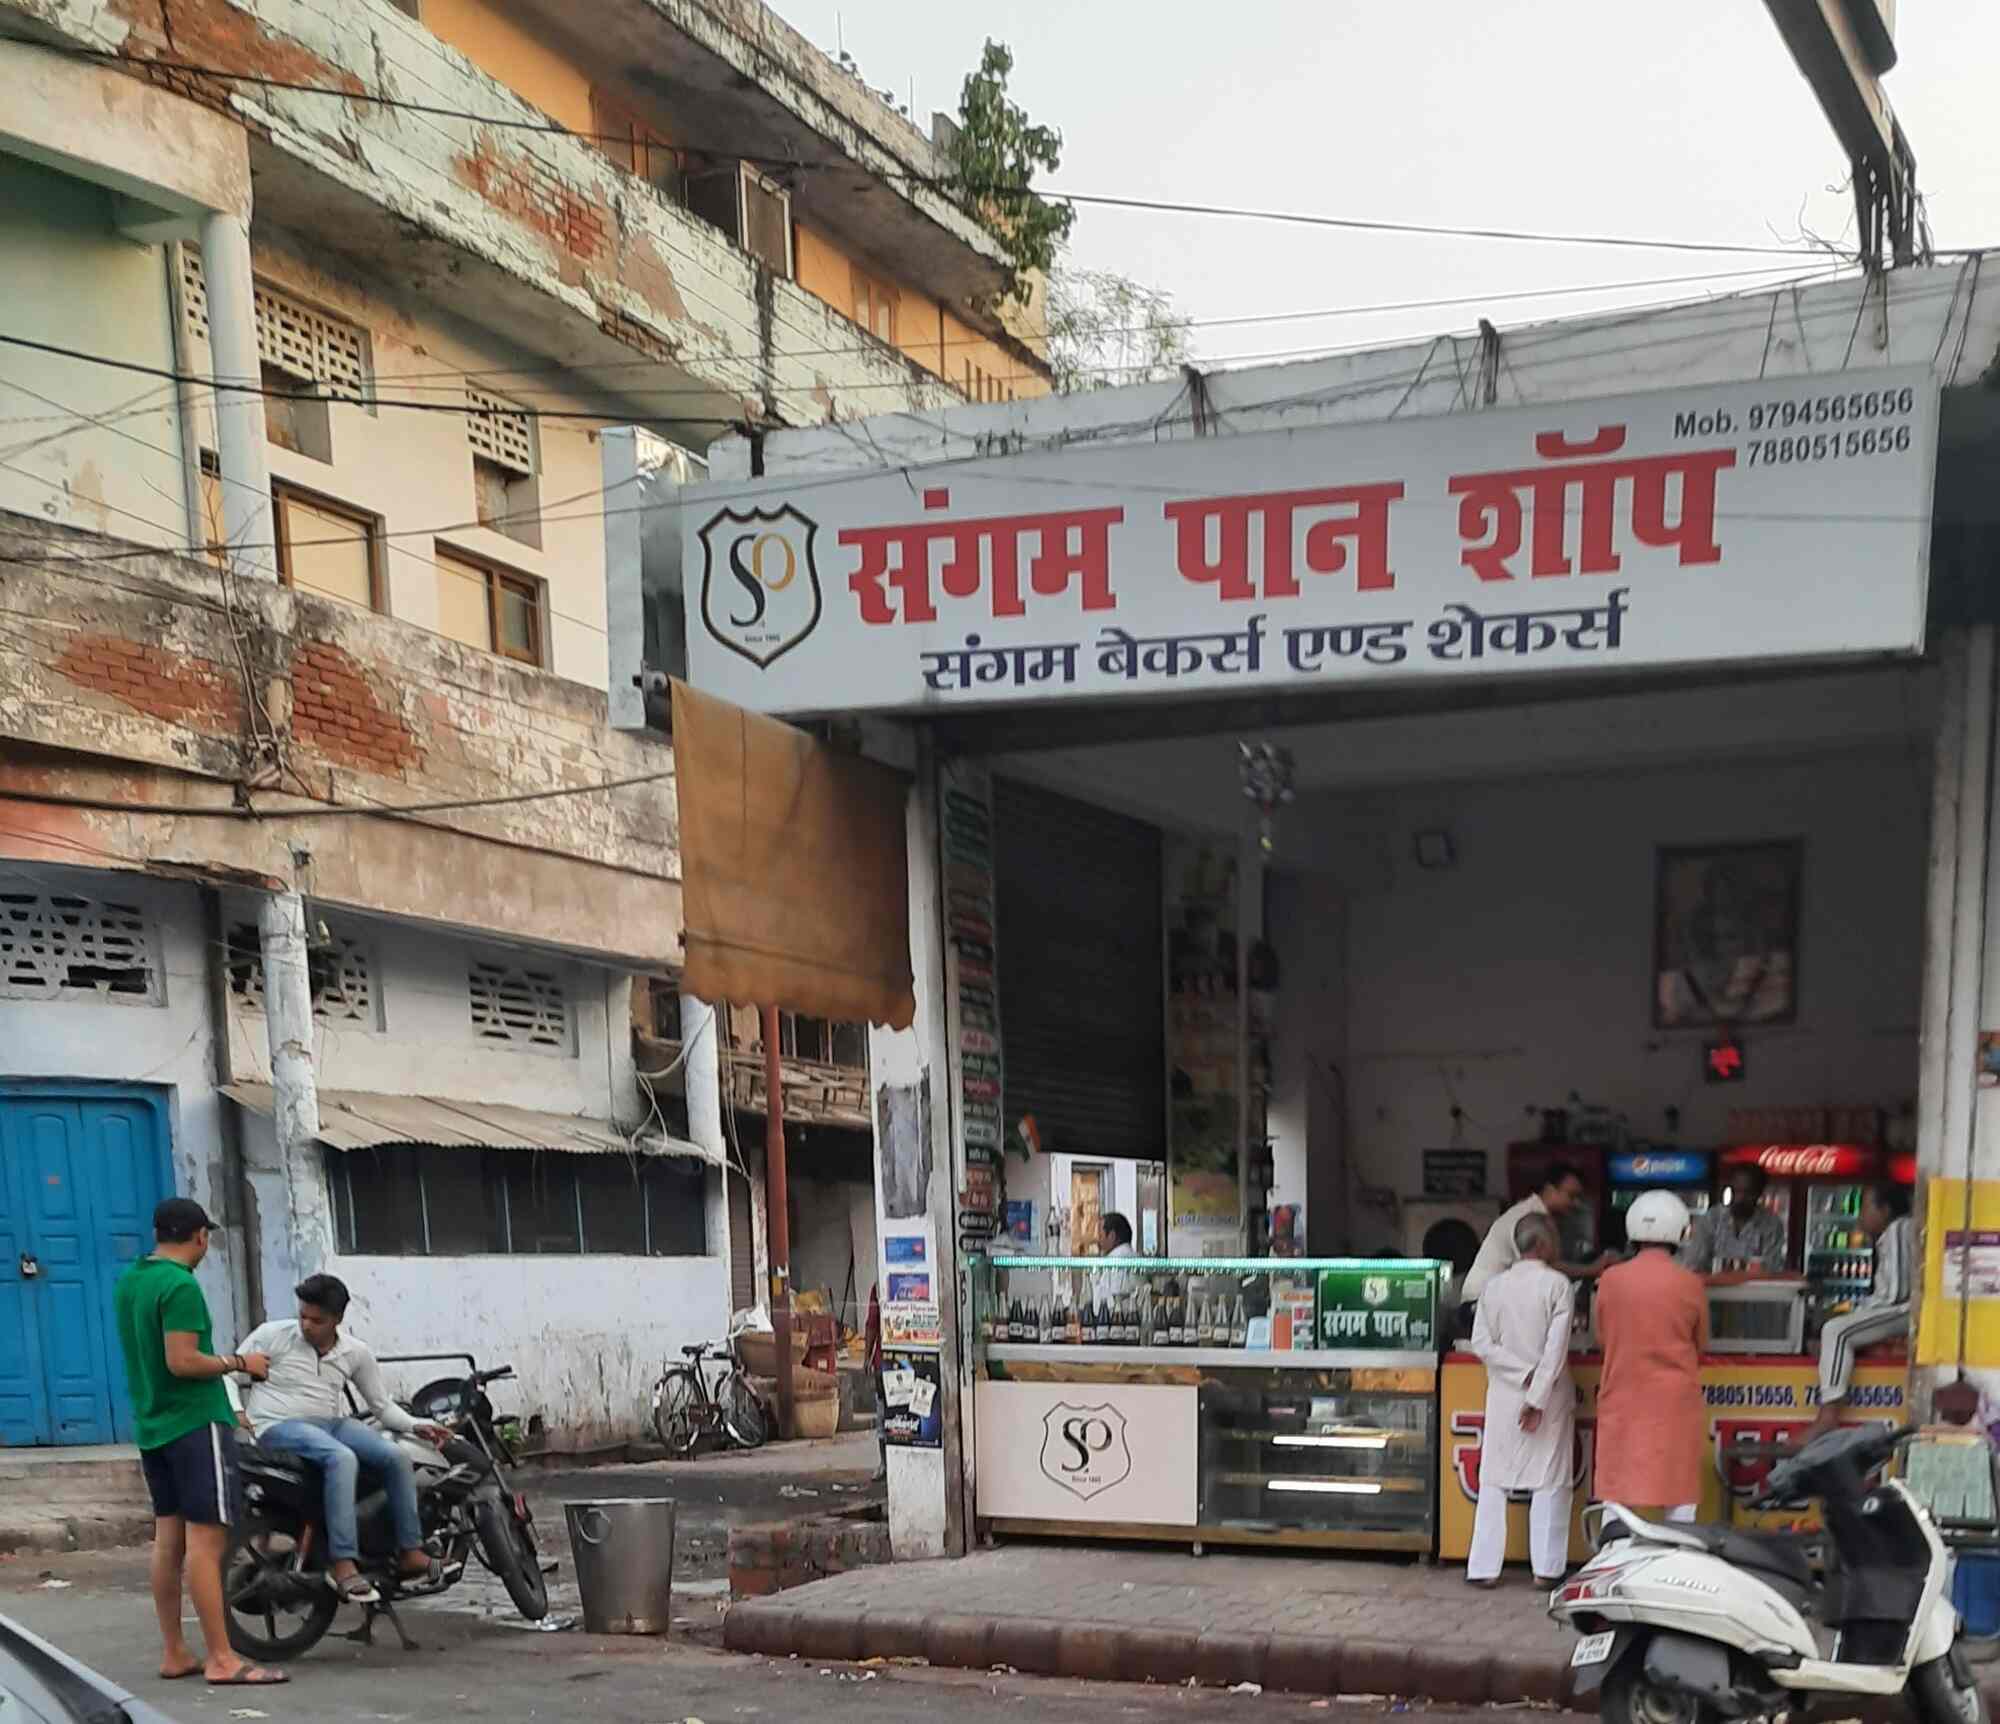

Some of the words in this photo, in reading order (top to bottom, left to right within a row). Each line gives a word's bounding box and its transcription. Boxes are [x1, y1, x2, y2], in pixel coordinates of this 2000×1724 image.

[1674, 408, 1739, 438] Mob.
[1749, 387, 1913, 430] 9794565656
[1748, 425, 1911, 467] 7880515656
[838, 487, 1124, 625] संगम
[1164, 480, 1405, 602] पान
[1448, 424, 1737, 582] शॉप
[919, 633, 1080, 690] संगम
[1097, 614, 1267, 680] बेकर्स
[1282, 620, 1414, 672] एण्ड
[1427, 588, 1630, 659] शेकर्स
[1323, 1303, 1369, 1337] संगम
[1373, 1310, 1408, 1338] पान
